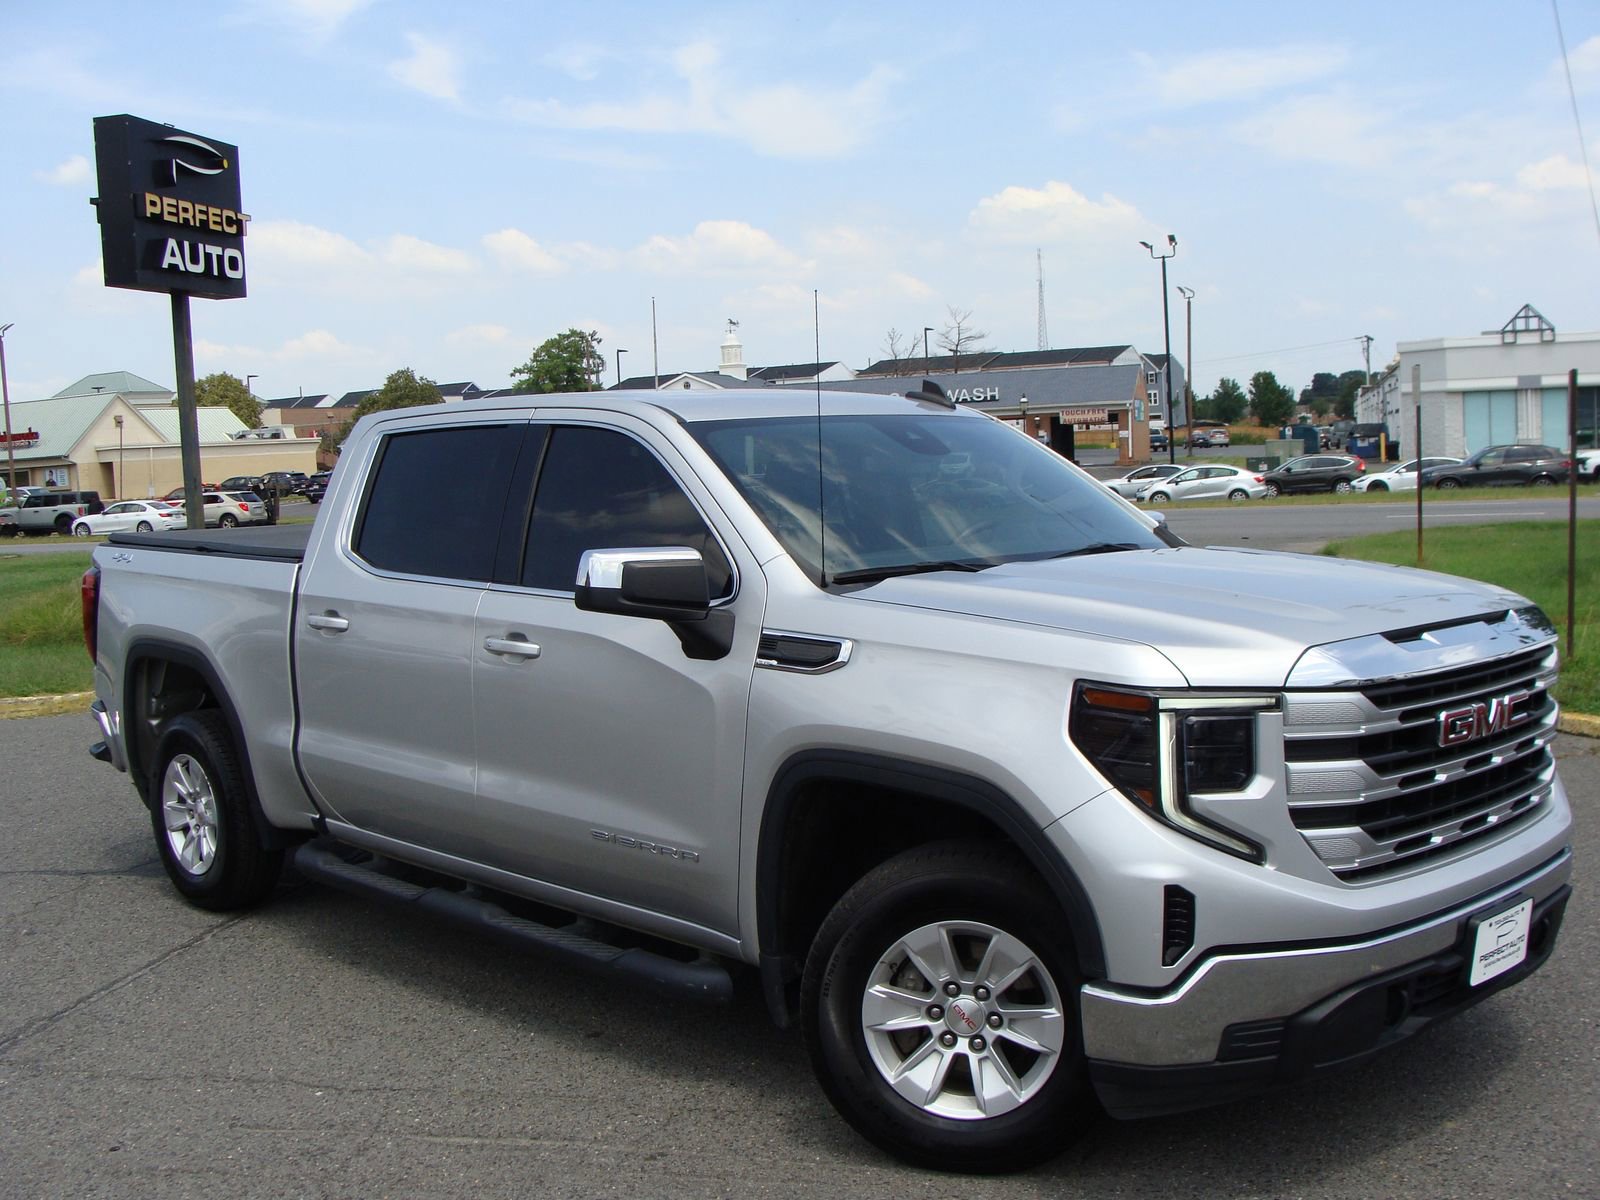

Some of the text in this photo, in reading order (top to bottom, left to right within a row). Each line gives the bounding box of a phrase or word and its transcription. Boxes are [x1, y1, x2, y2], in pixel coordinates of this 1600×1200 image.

[145, 192, 251, 236] PERFECT
[162, 237, 243, 279] AUTO
[1061, 409, 1085, 417] TOUCH
[1062, 416, 1106, 424] AUTOMATIC
[1439, 689, 1529, 747] GMC
[590, 828, 699, 863] SIERRA
[1479, 942, 1510, 963] PERFECT
[1509, 933, 1525, 948] AUTO
[953, 1004, 977, 1030] GMC
